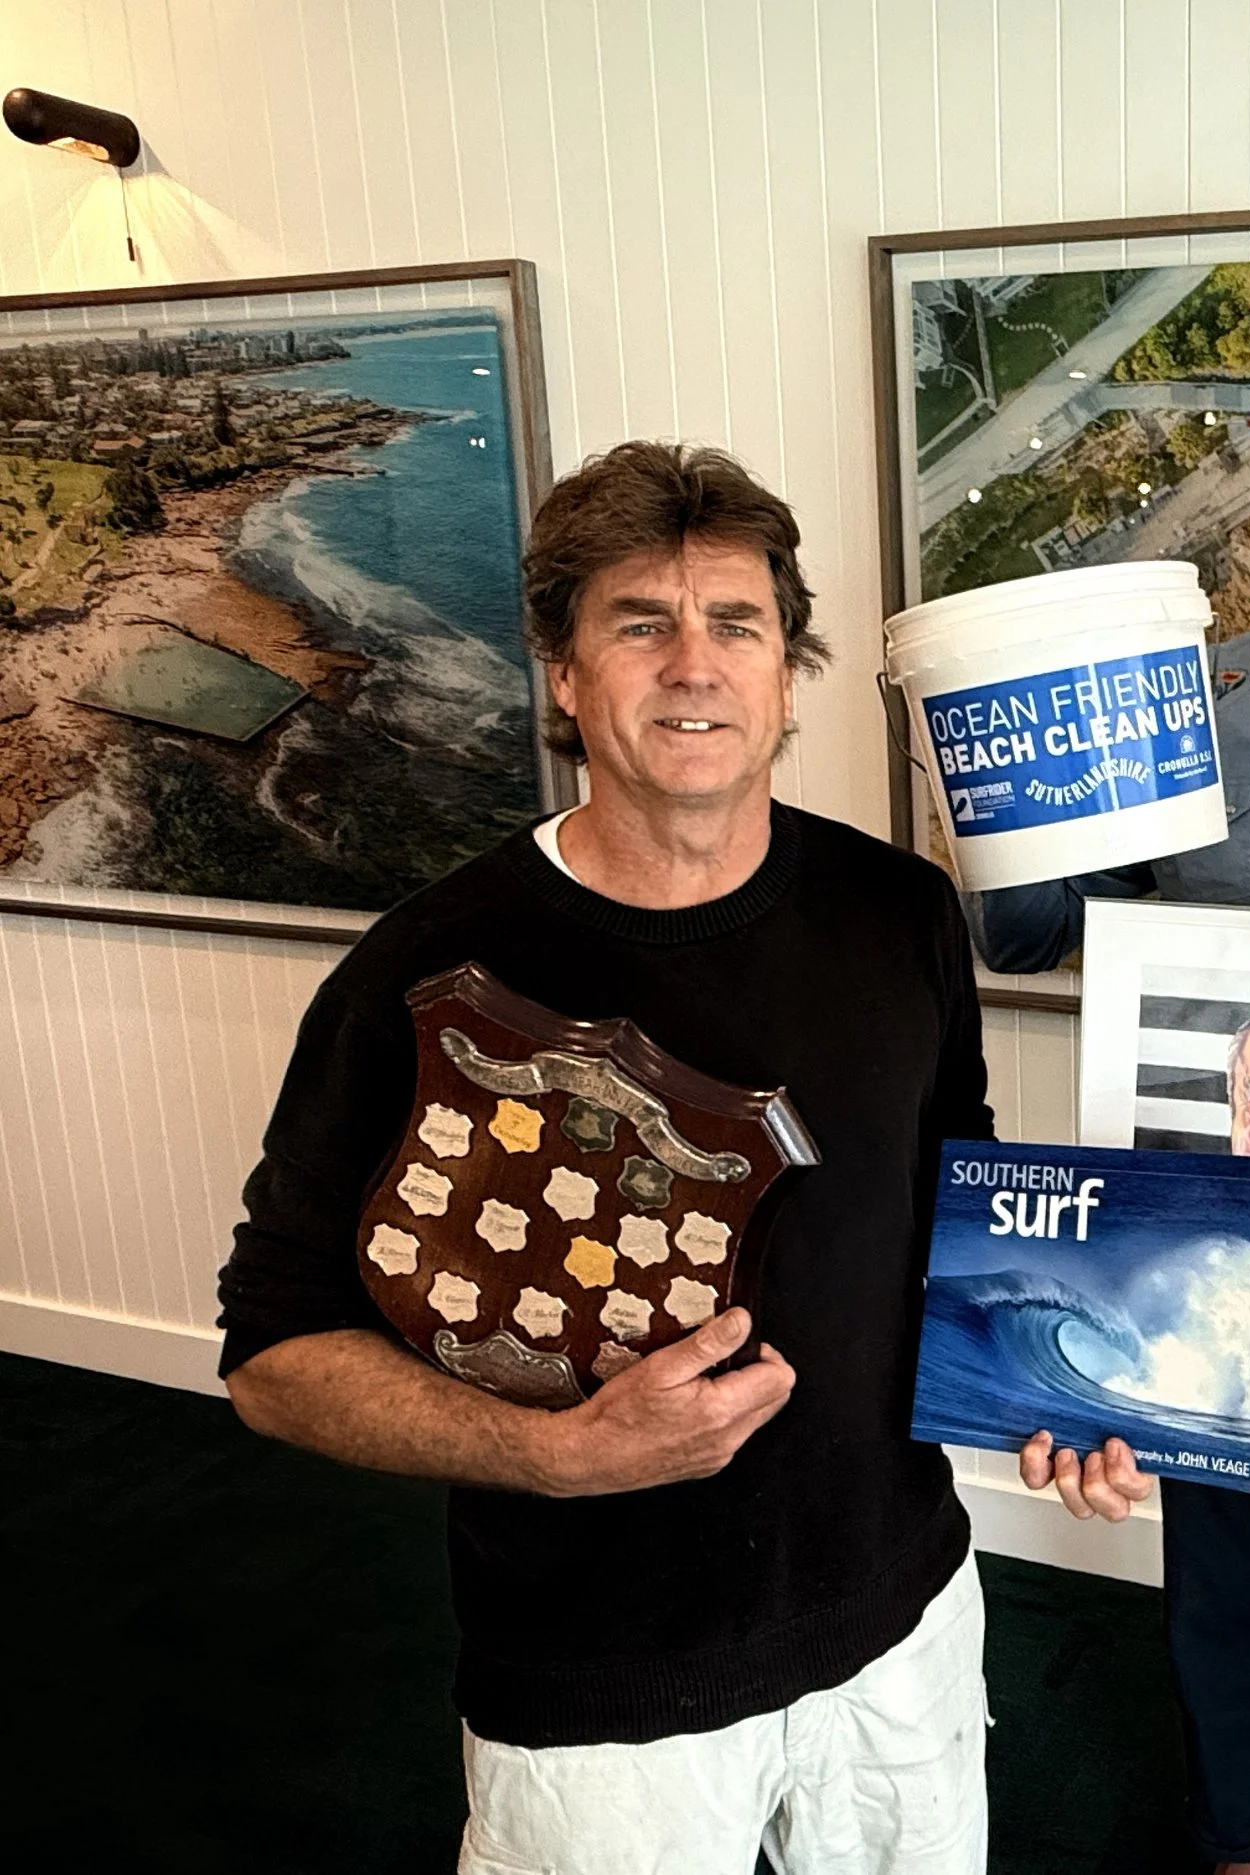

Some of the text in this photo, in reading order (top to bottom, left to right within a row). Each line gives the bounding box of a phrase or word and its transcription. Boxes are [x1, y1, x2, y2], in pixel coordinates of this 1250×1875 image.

[932, 660, 1198, 742] OCEAN FRIENDLY
[940, 696, 1205, 776] BEACH CLEAN UPS
[1158, 754, 1199, 774] CRONULLA
[970, 781, 1013, 799] SURFRIDER
[951, 1160, 1074, 1191] SOUTHERN
[989, 1178, 1105, 1241] surf
[1176, 1451, 1208, 1469] JOHN
[1211, 1457, 1250, 1477] VEAGE
